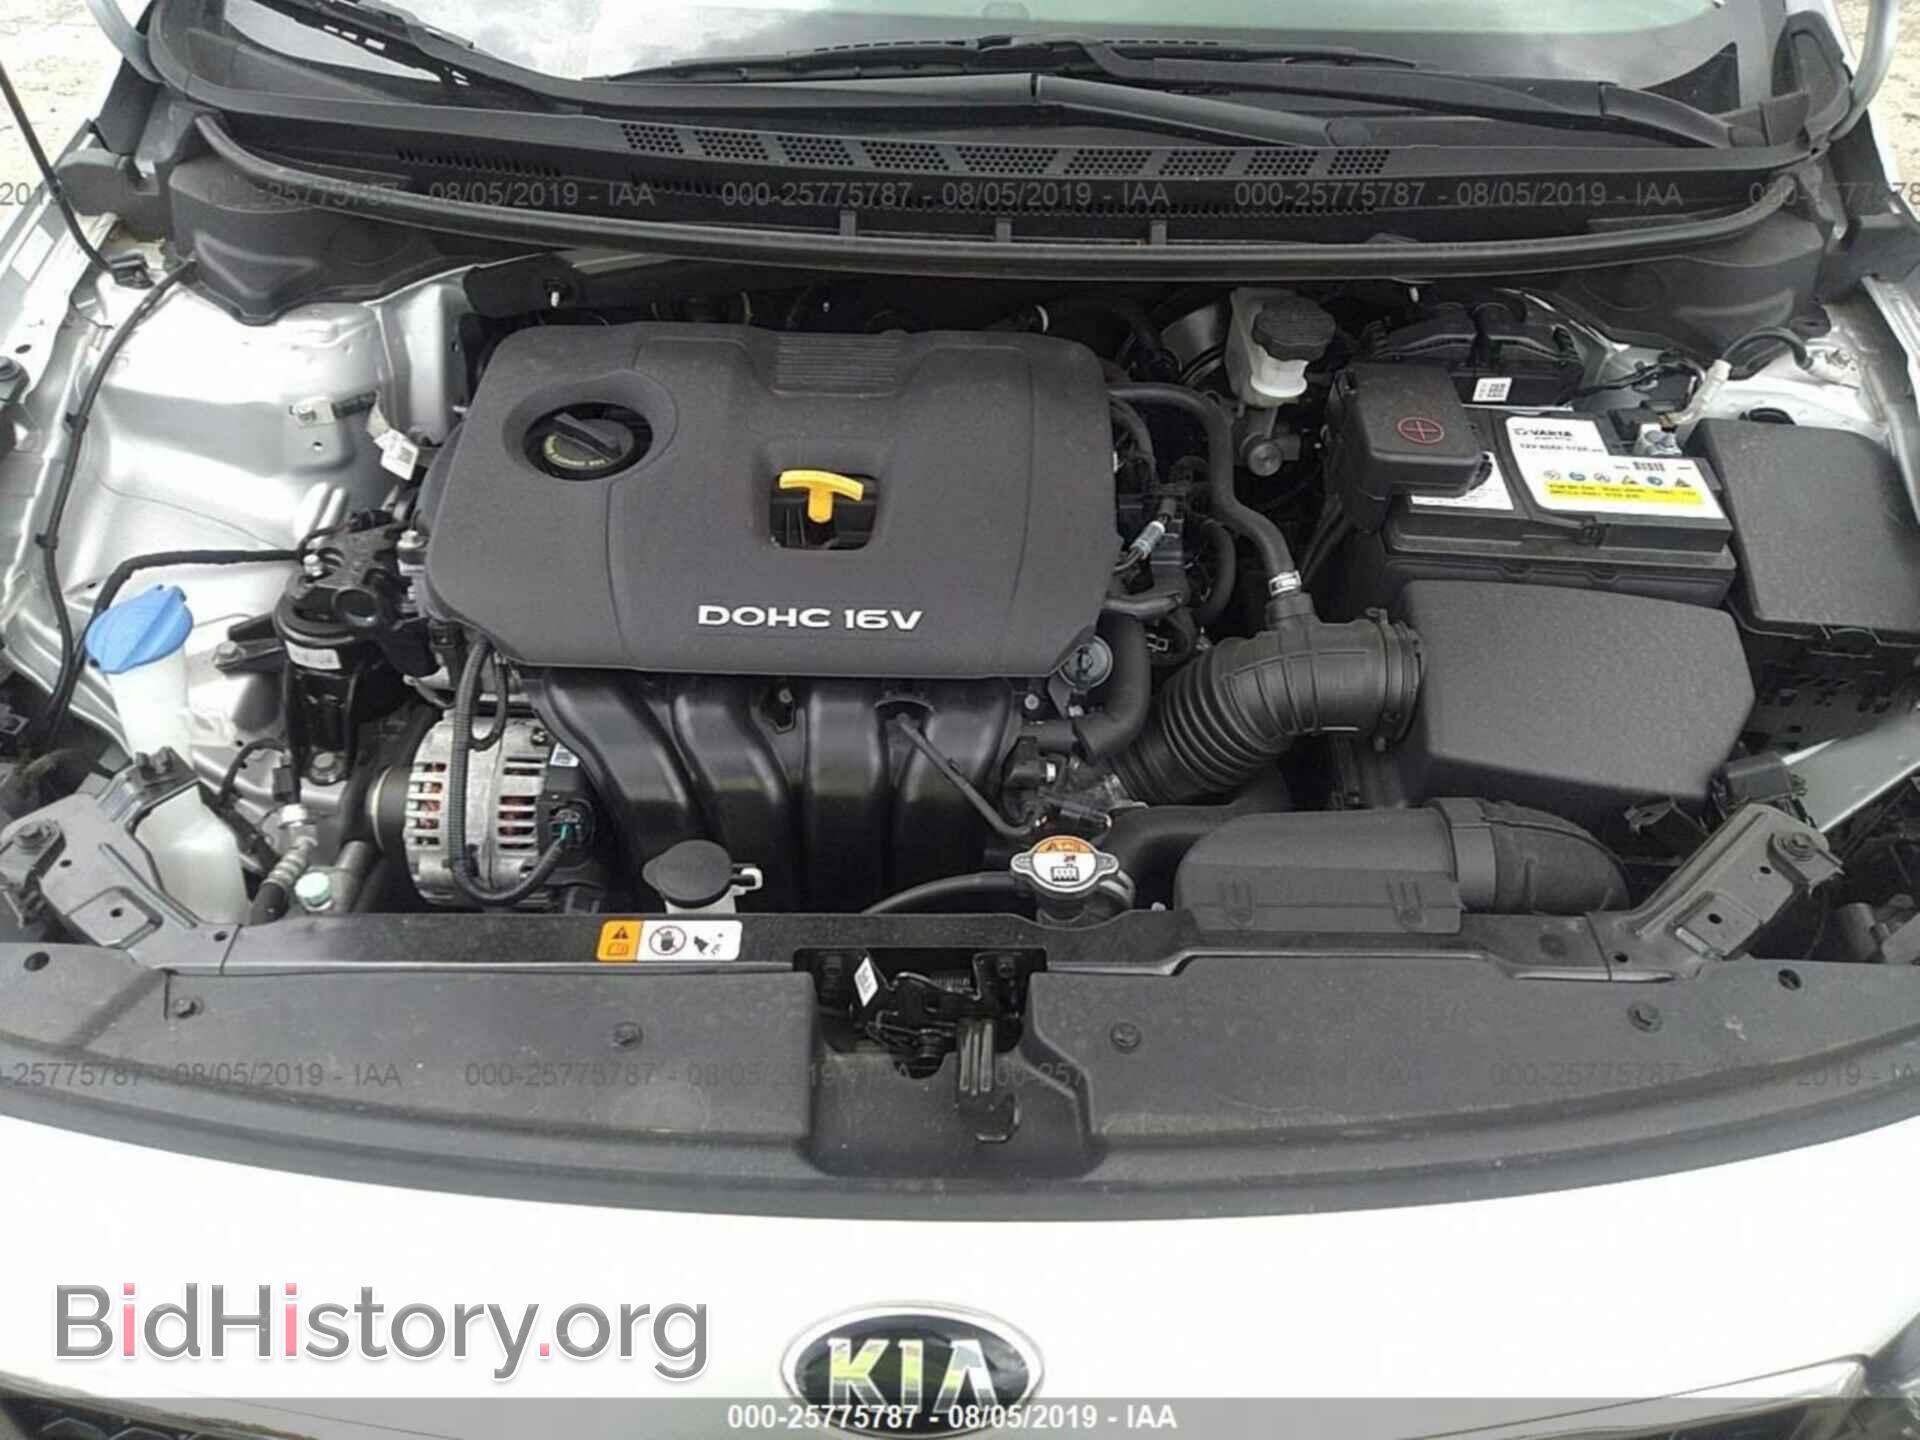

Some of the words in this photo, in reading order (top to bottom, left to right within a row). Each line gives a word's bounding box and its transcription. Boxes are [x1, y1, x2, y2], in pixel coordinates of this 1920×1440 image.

[698, 604, 832, 628] DOHC
[844, 608, 924, 631] 16V
[827, 1336, 1001, 1415] KIA
